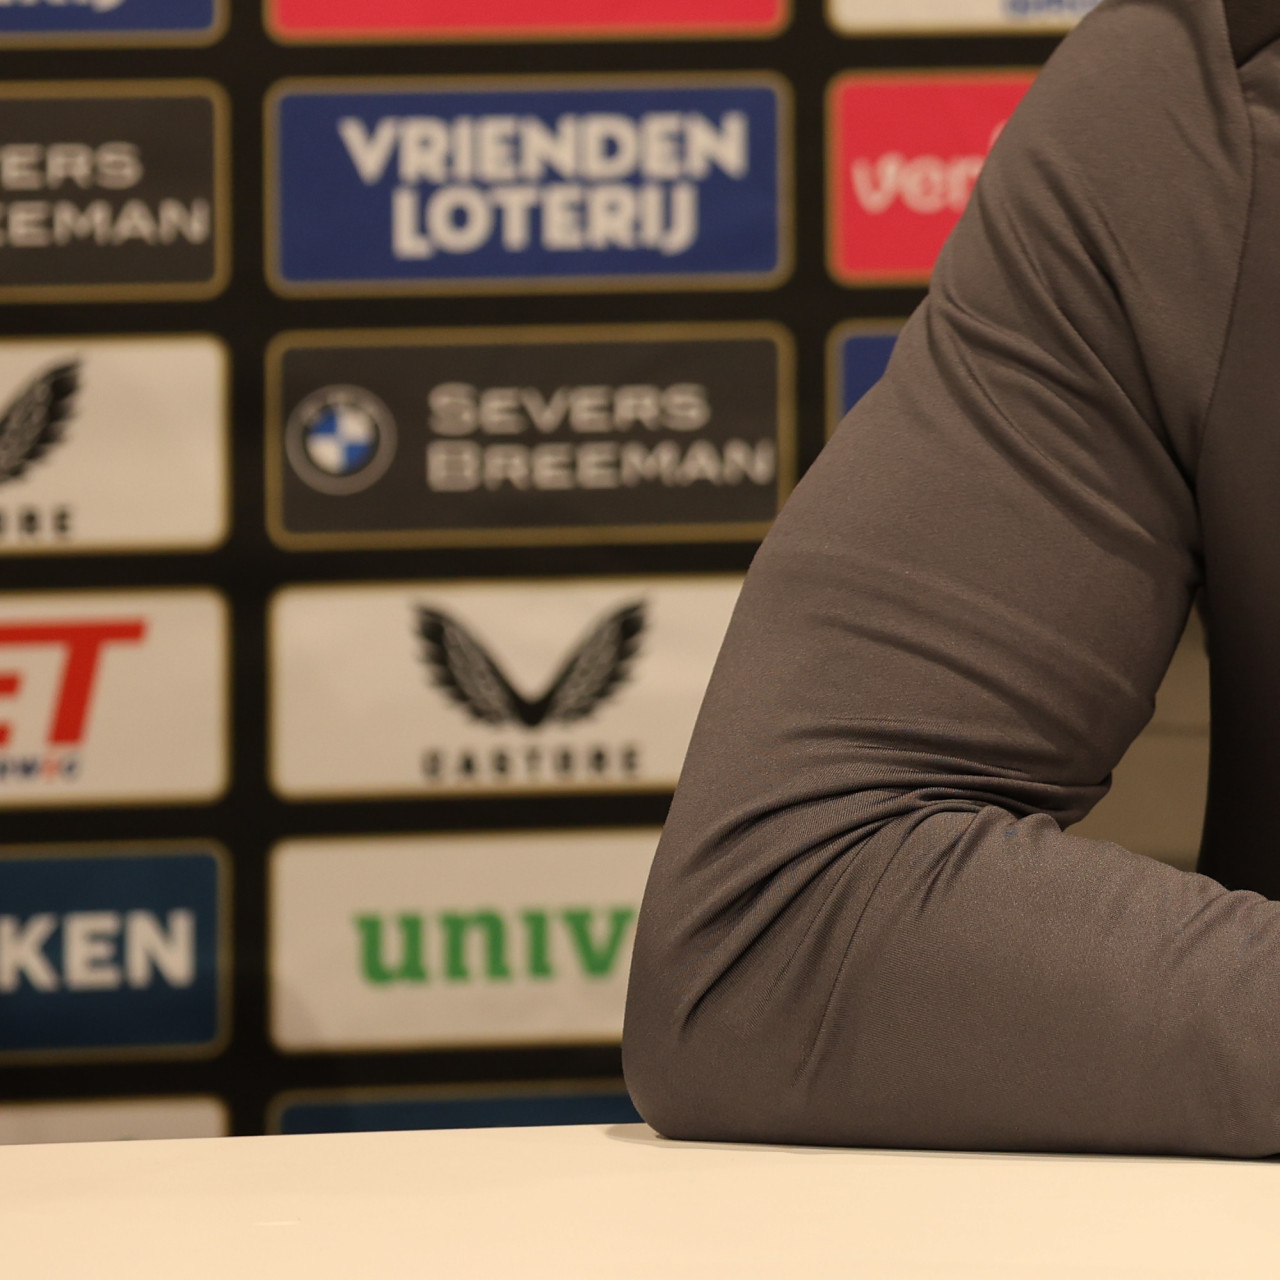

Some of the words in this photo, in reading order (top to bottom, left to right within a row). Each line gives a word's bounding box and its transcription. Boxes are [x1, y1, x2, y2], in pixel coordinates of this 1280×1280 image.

[338, 111, 749, 184] VRIENDEN
[0, 198, 208, 247] EMAN
[392, 183, 698, 259] LOTERIJ
[427, 382, 711, 434] SEVERS
[426, 438, 775, 491] BREEMAN
